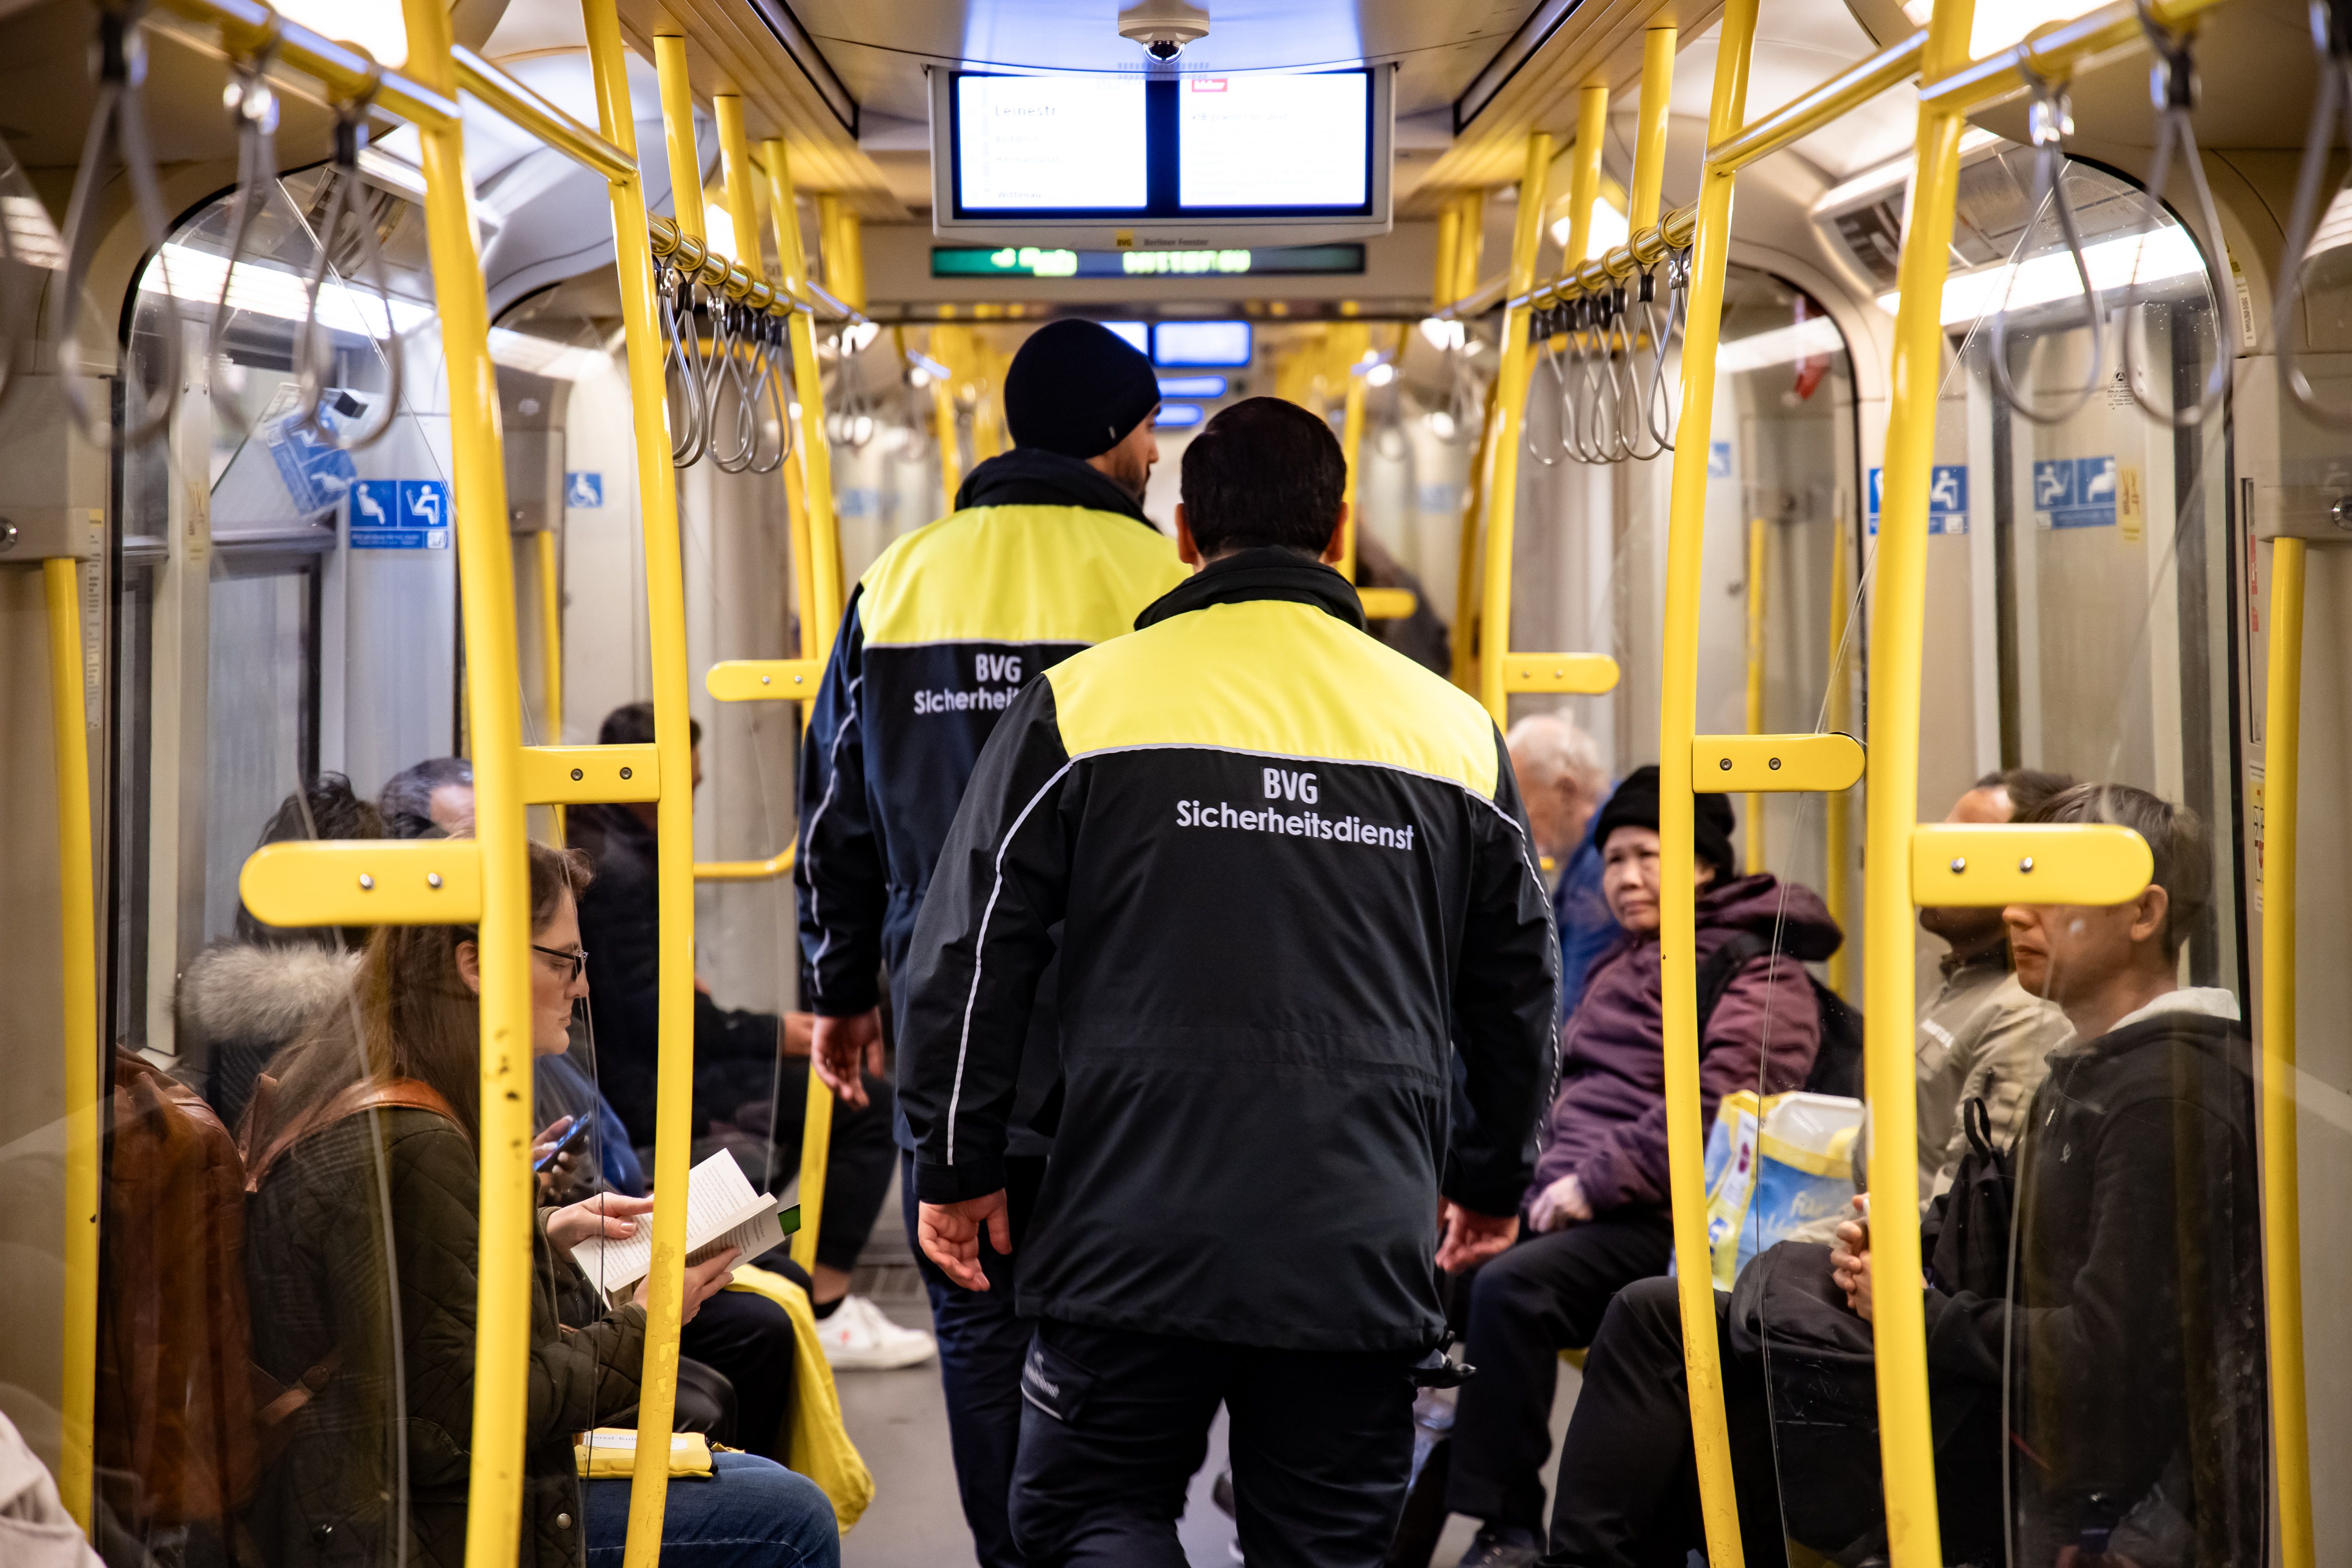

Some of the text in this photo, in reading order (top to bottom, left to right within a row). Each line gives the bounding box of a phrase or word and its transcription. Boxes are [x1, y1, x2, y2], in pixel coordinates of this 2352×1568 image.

[975, 653, 1023, 683] BVG
[1263, 767, 1318, 804] BVG
[1176, 800, 1414, 850] Sicherheitsdienst
